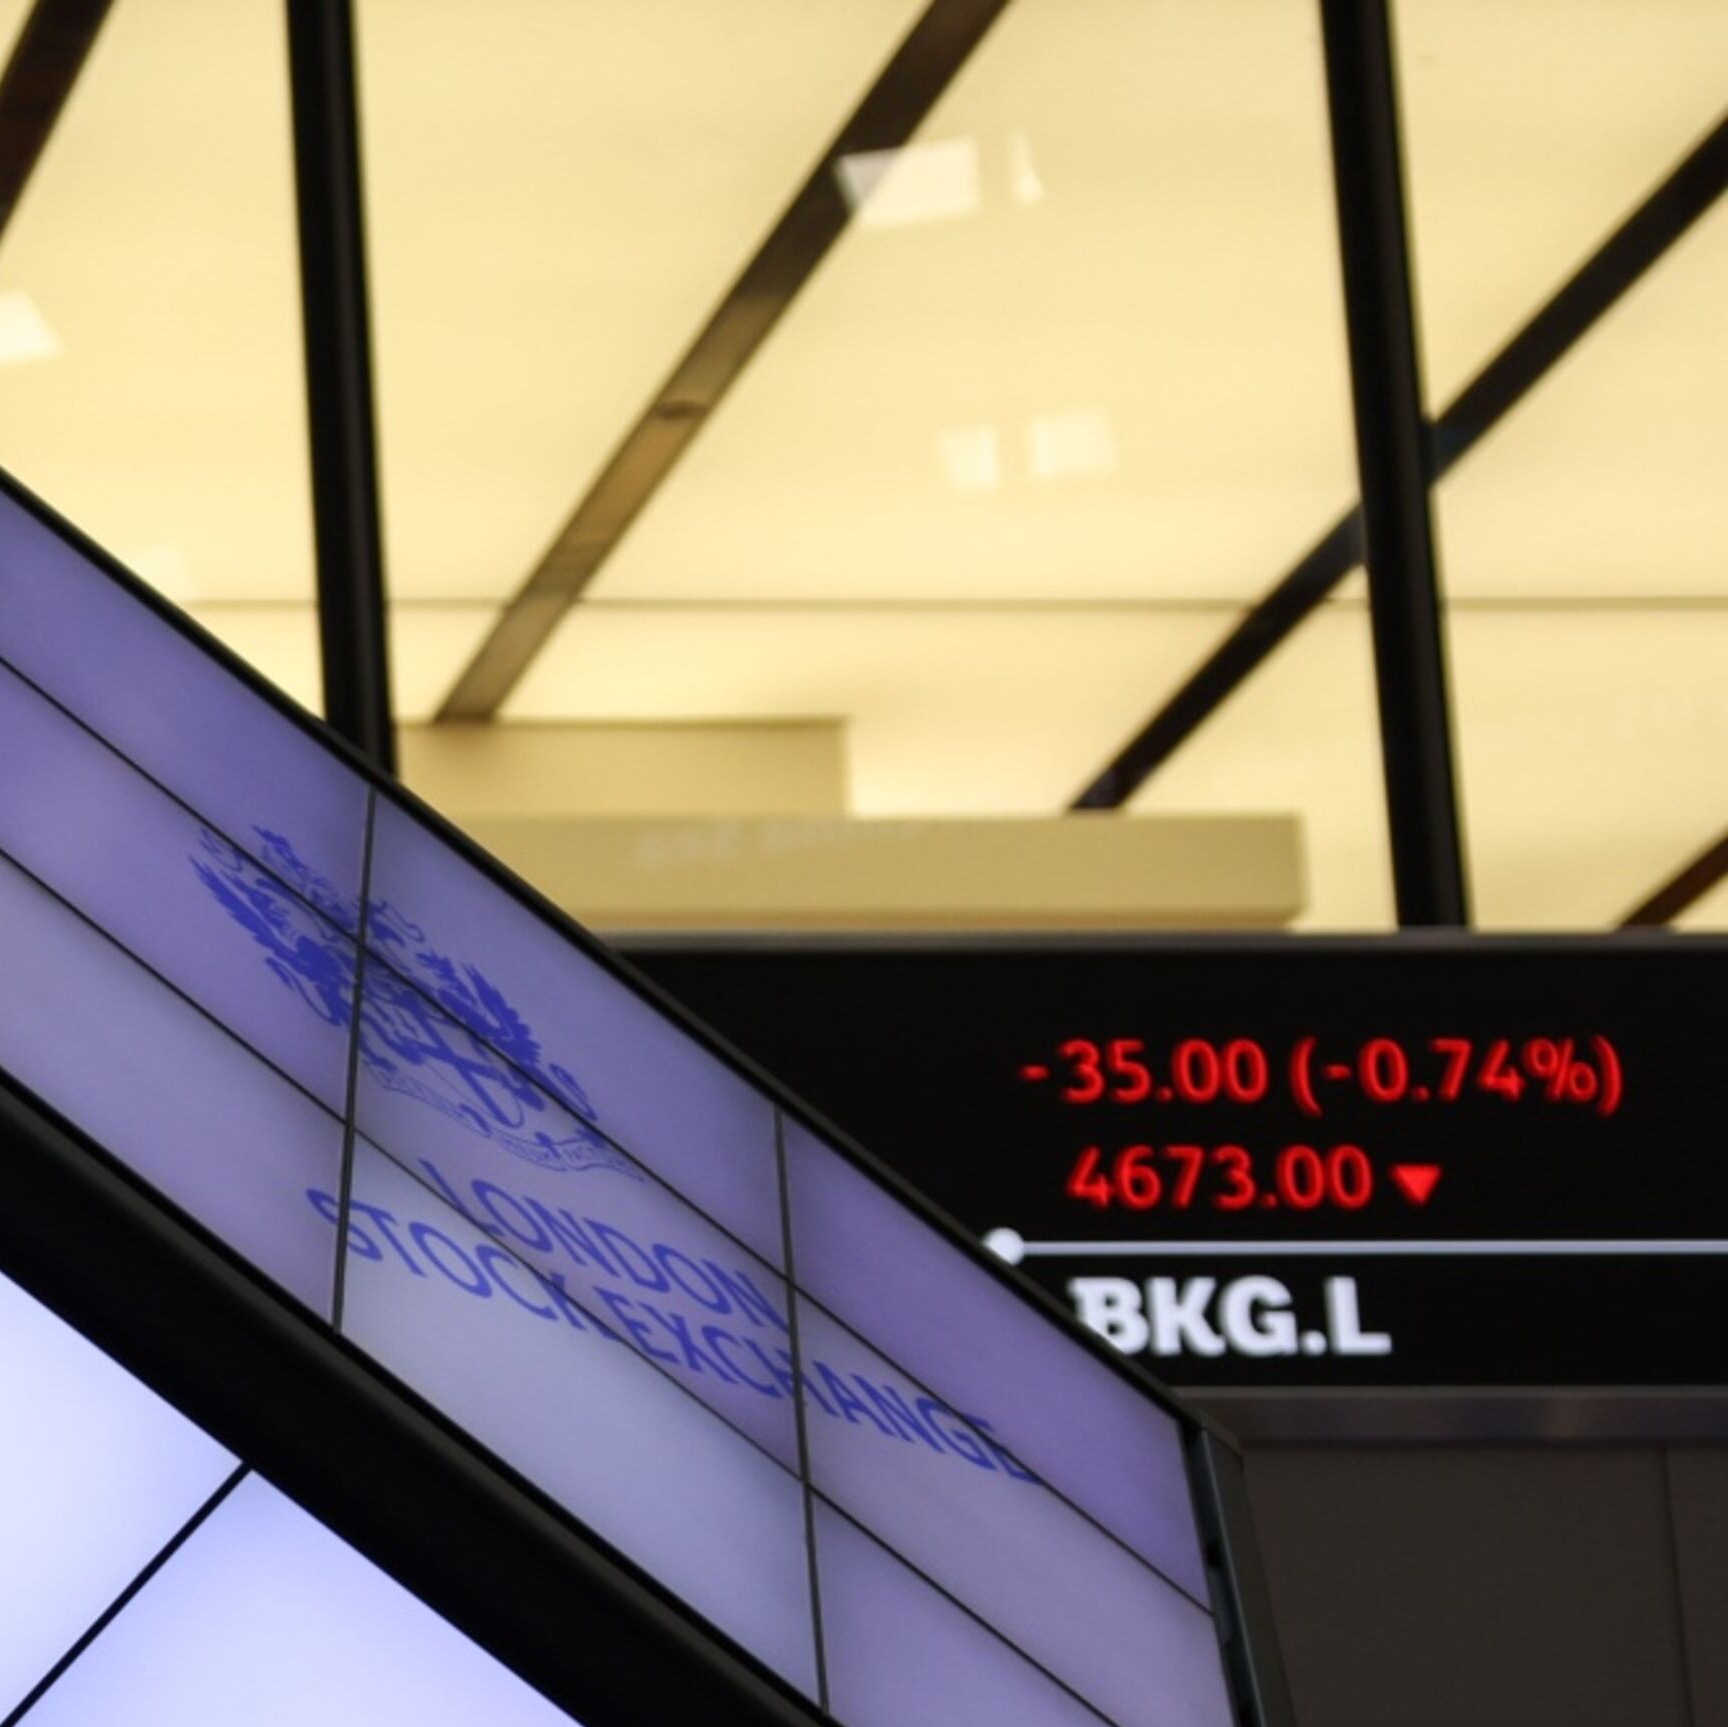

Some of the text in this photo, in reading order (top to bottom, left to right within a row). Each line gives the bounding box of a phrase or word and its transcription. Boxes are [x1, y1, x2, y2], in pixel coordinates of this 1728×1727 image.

[1022, 1036, 1624, 1115] -35.00 (-0.74%)
[1067, 1143, 1374, 1211] 4673.00
[418, 1158, 791, 1333] LONDON
[305, 1188, 1044, 1486] STOCK EXCHANGE
[1070, 1277, 1392, 1355] BKG.L
